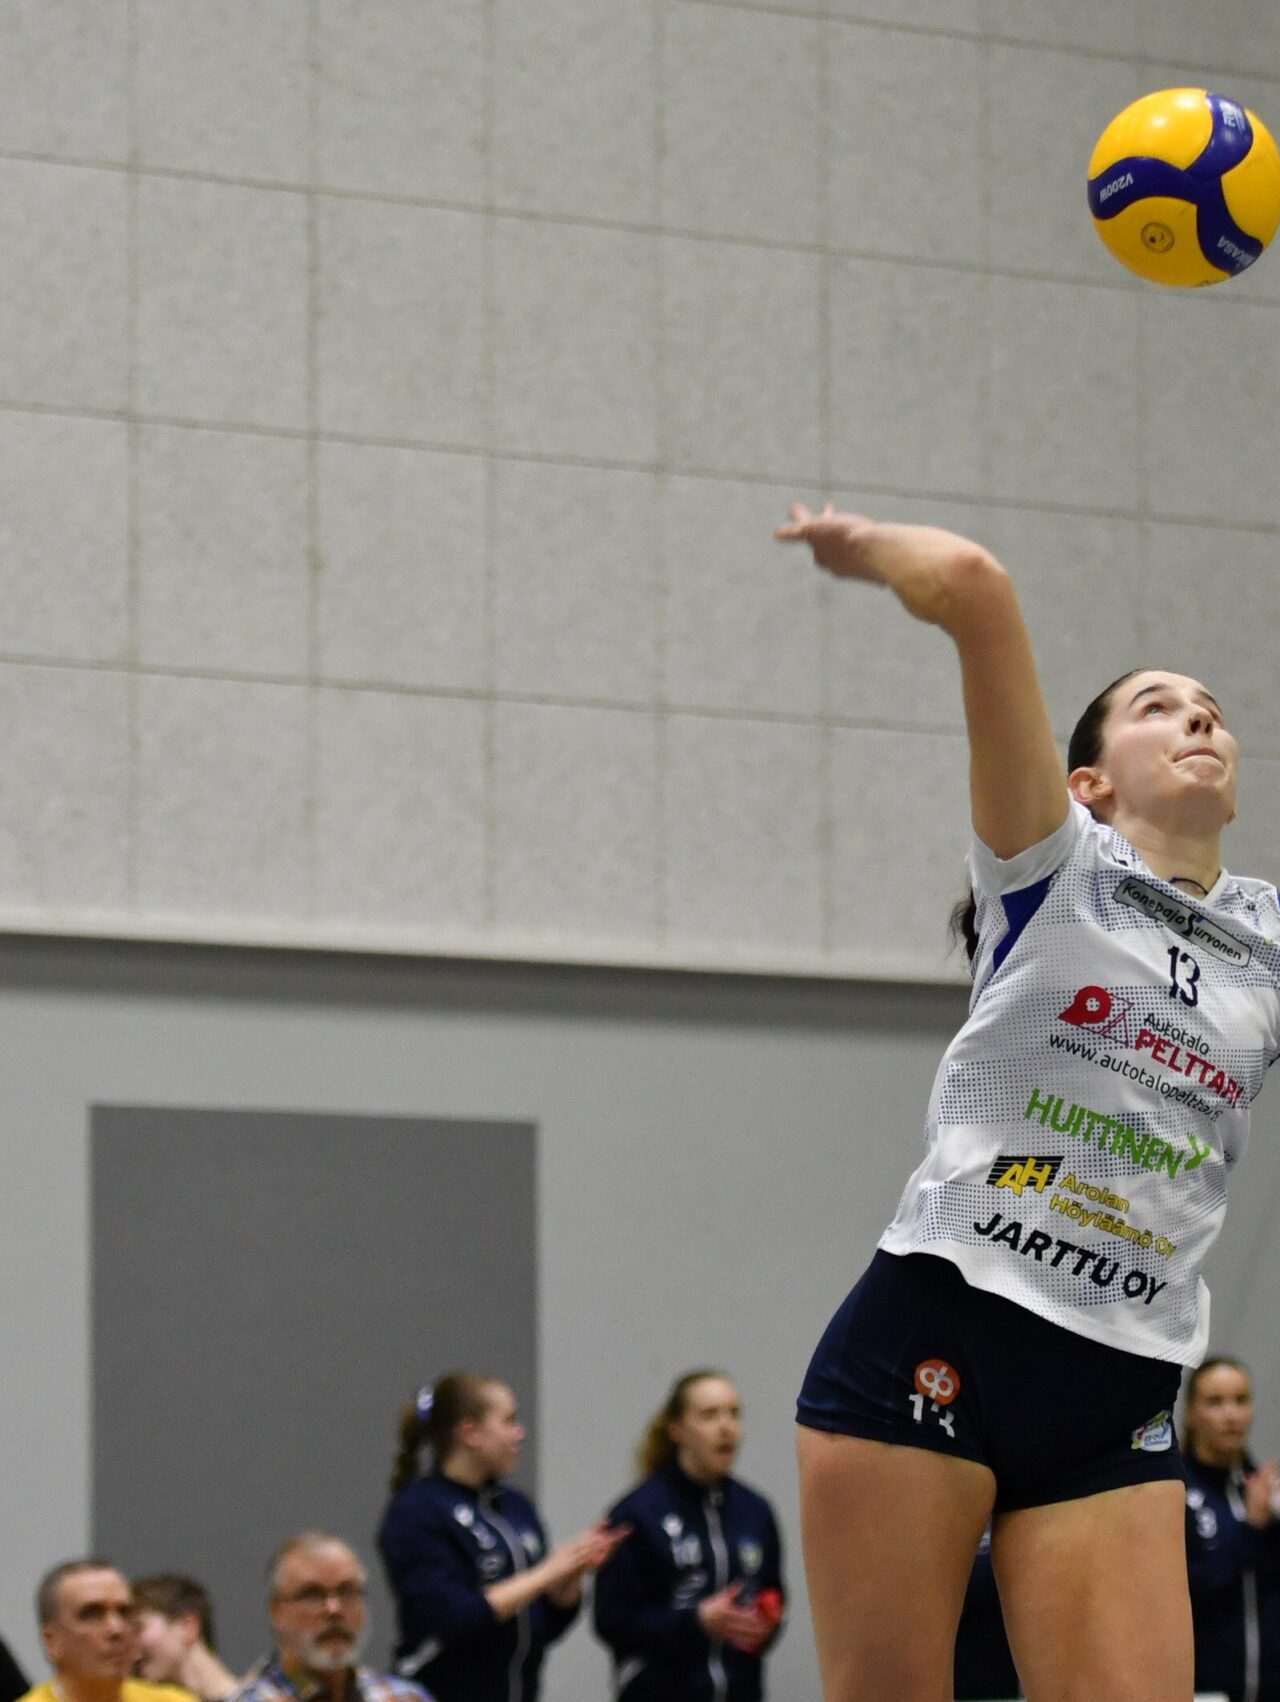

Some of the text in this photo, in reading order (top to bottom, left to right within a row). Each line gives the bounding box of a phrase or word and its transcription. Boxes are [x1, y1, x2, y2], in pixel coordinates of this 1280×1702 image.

[1100, 172, 1134, 203] V200W
[1122, 883, 1242, 961] Konepaja Survonen
[1167, 945, 1200, 1007] 13
[1143, 1012, 1210, 1055] Autotalo
[1135, 1028, 1244, 1109] PELTTARI
[1025, 1088, 1185, 1179] HUITTINEN
[995, 1157, 1052, 1197] AH
[1058, 1172, 1131, 1214] Arolan
[1049, 1193, 1153, 1249] Höyläämö
[973, 1212, 1168, 1306] JARTTU OY
